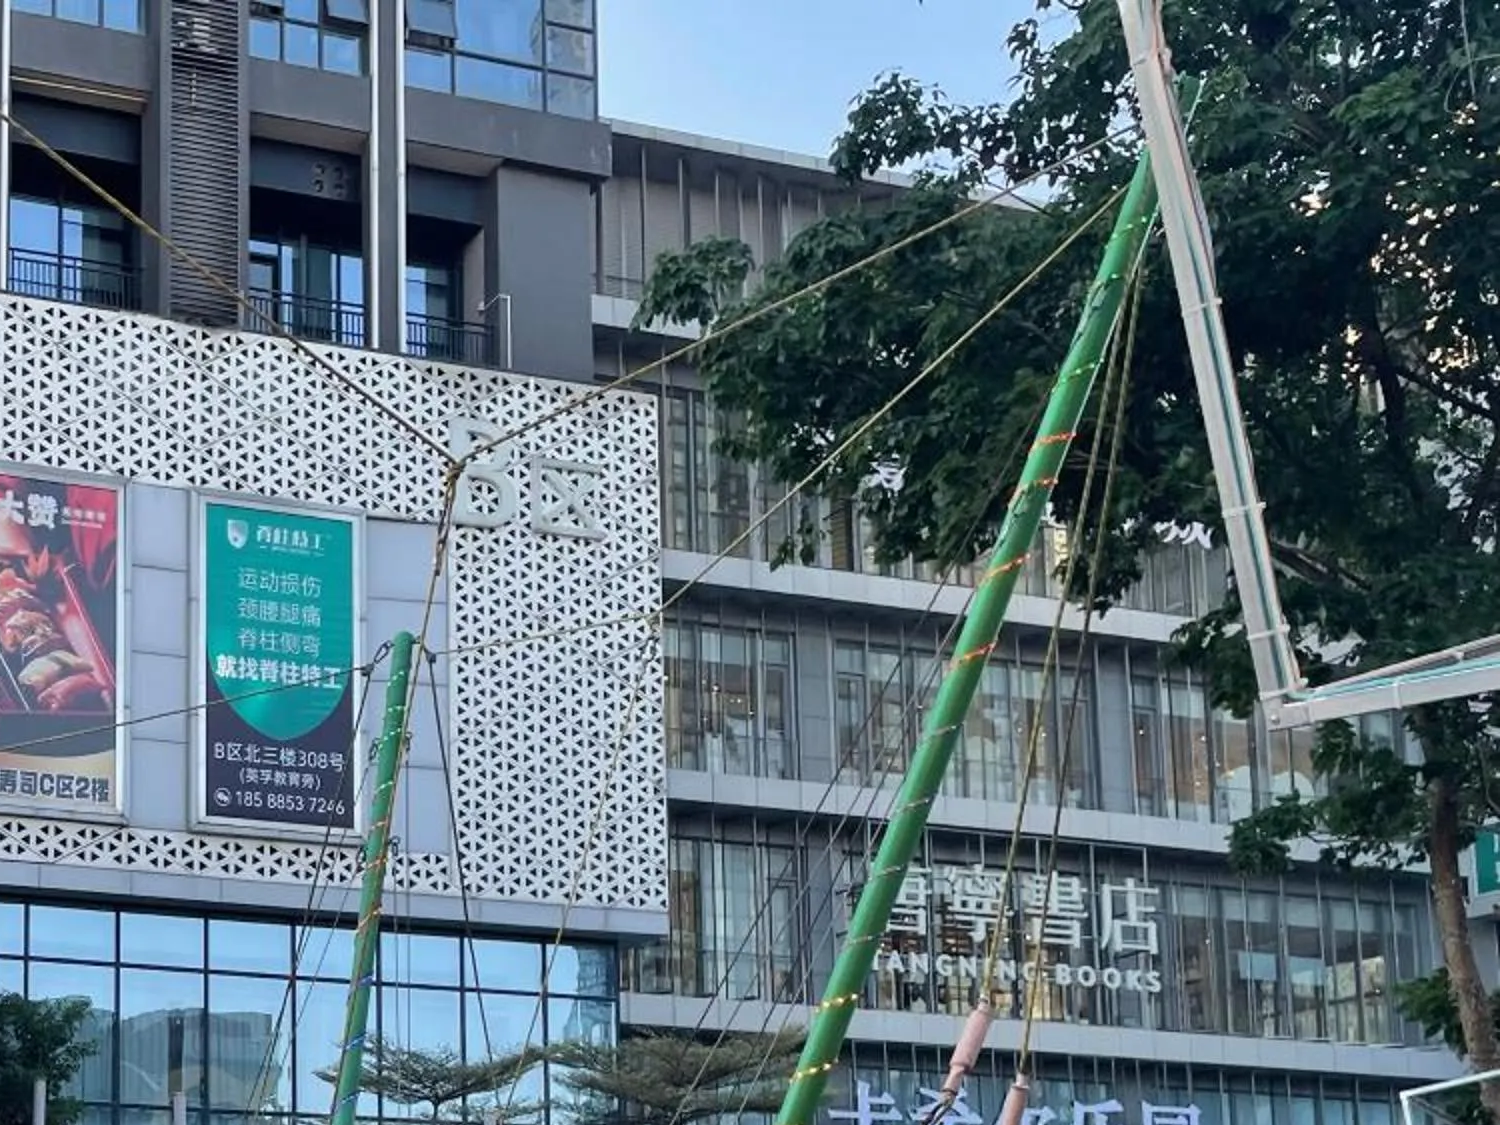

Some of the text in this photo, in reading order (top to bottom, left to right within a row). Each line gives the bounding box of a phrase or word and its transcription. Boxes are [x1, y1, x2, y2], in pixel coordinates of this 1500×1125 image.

[238, 567, 323, 599] 运动损伤
[238, 597, 321, 628] 颈腰腿痛
[238, 627, 321, 658] 脊柱侧弯
[215, 653, 343, 690] 就找脊柱特工
[213, 741, 345, 773] B区北三楼308号
[1054, 962, 1162, 993] BOOKS
